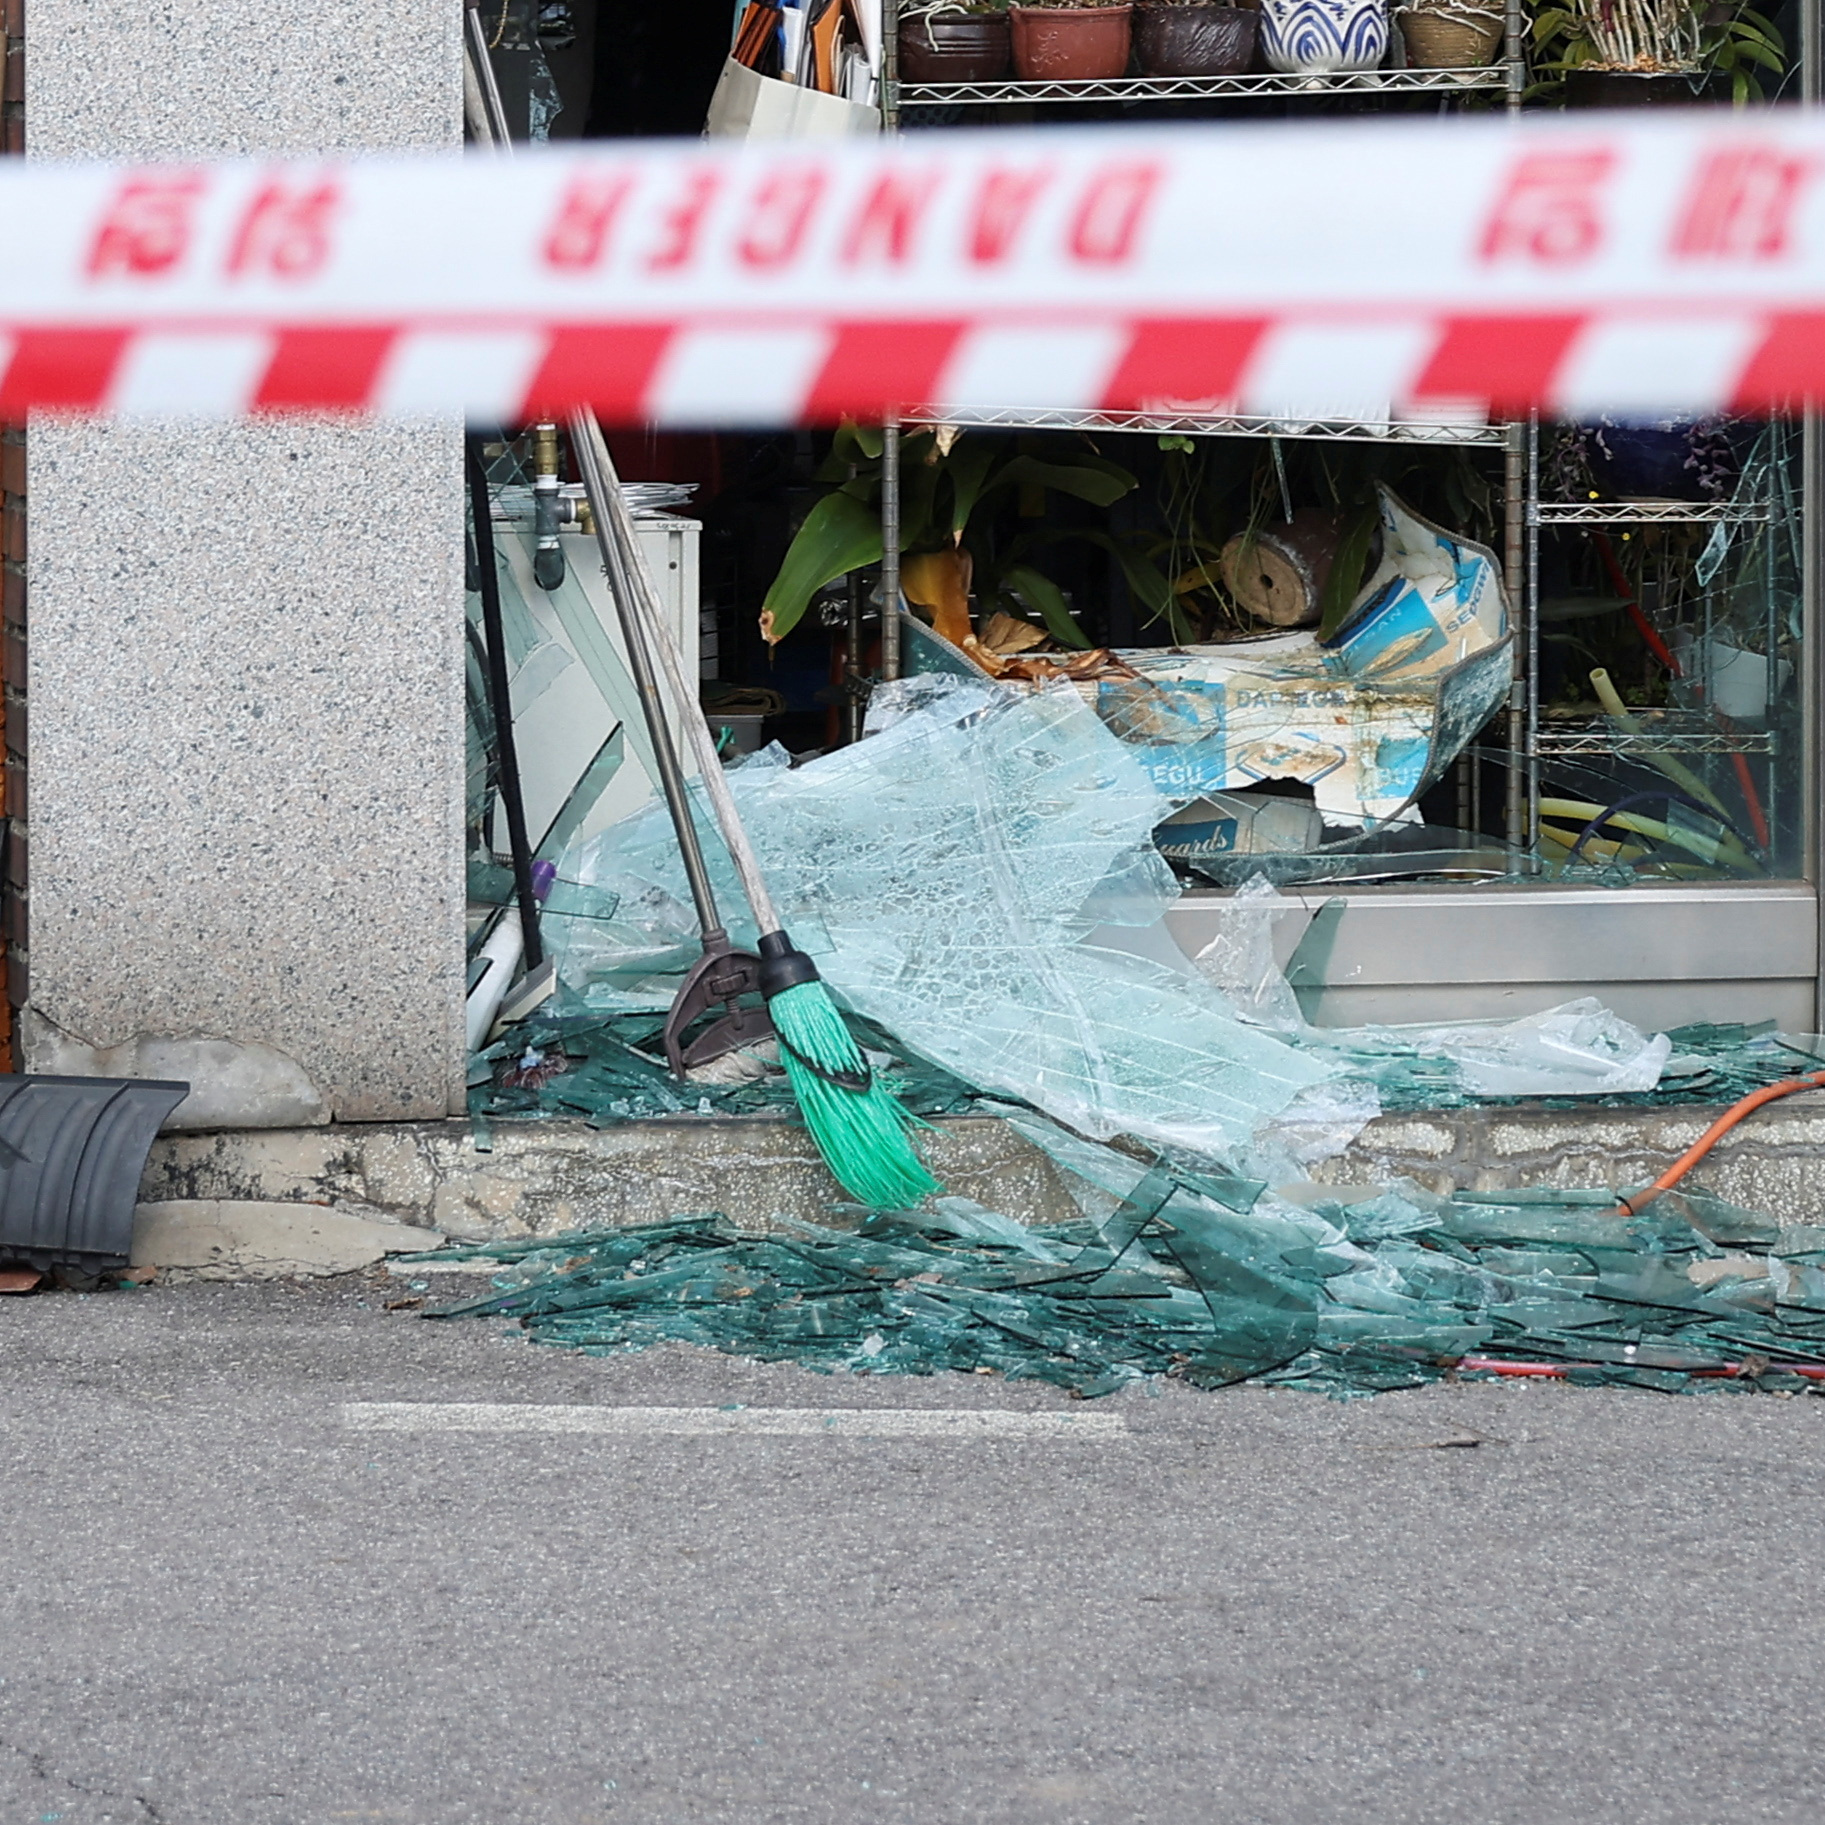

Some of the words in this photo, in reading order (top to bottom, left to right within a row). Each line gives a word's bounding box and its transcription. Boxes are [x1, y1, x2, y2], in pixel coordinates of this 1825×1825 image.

[81, 169, 344, 281] 위험
[540, 156, 1164, 274] DANGER
[1150, 764, 1205, 785] EGU
